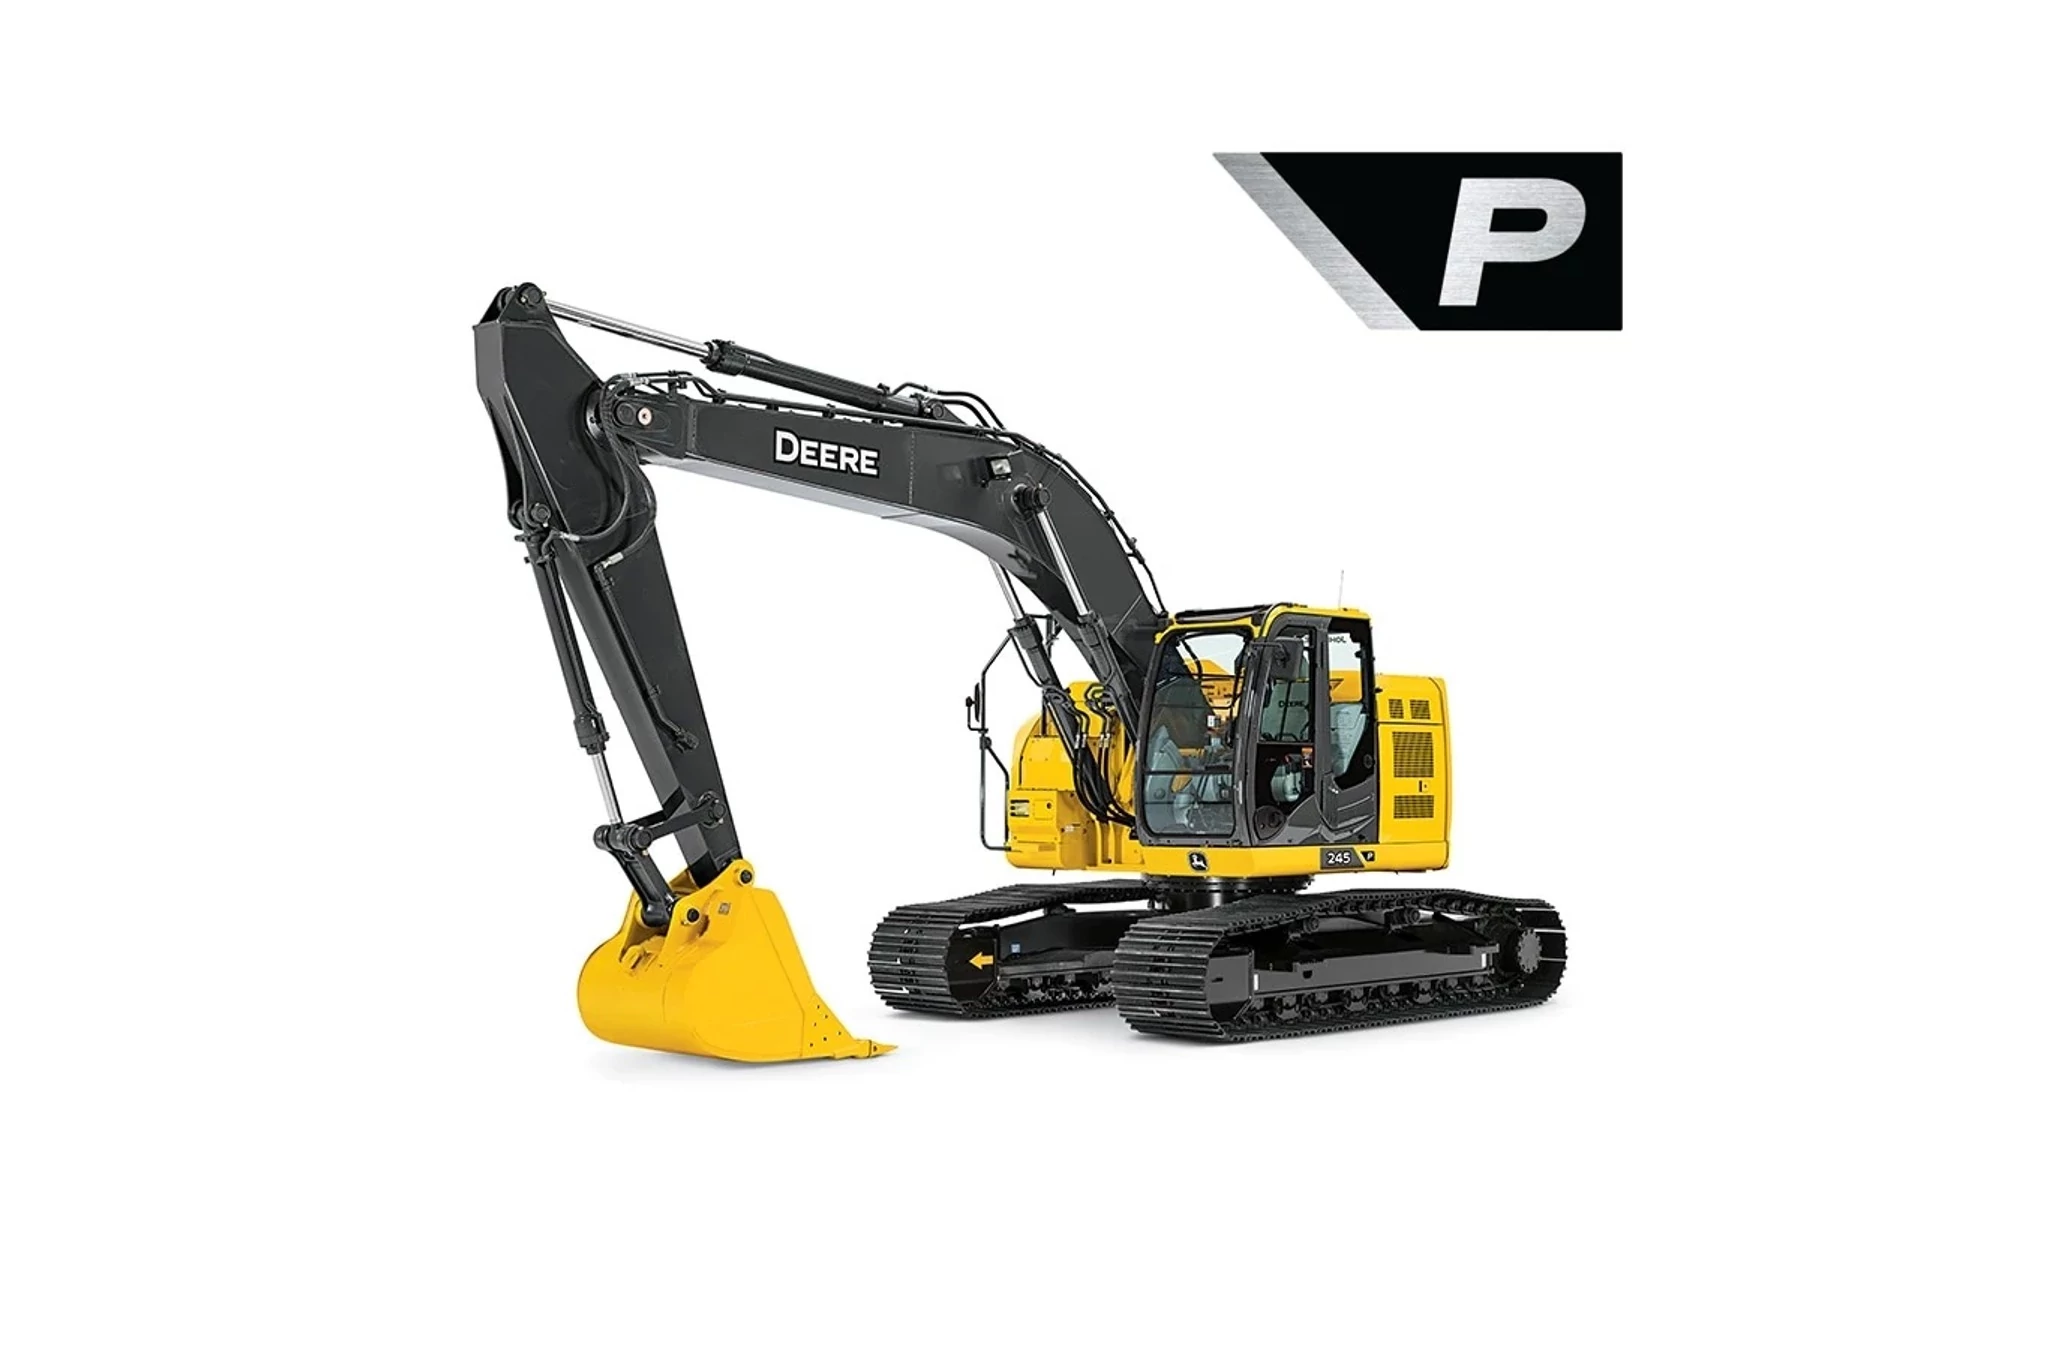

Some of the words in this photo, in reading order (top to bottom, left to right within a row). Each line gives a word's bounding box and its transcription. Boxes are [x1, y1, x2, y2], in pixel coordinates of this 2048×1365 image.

[775, 429, 879, 476] DEERE
[1327, 851, 1351, 864] 245
[1367, 852, 1374, 860] P
